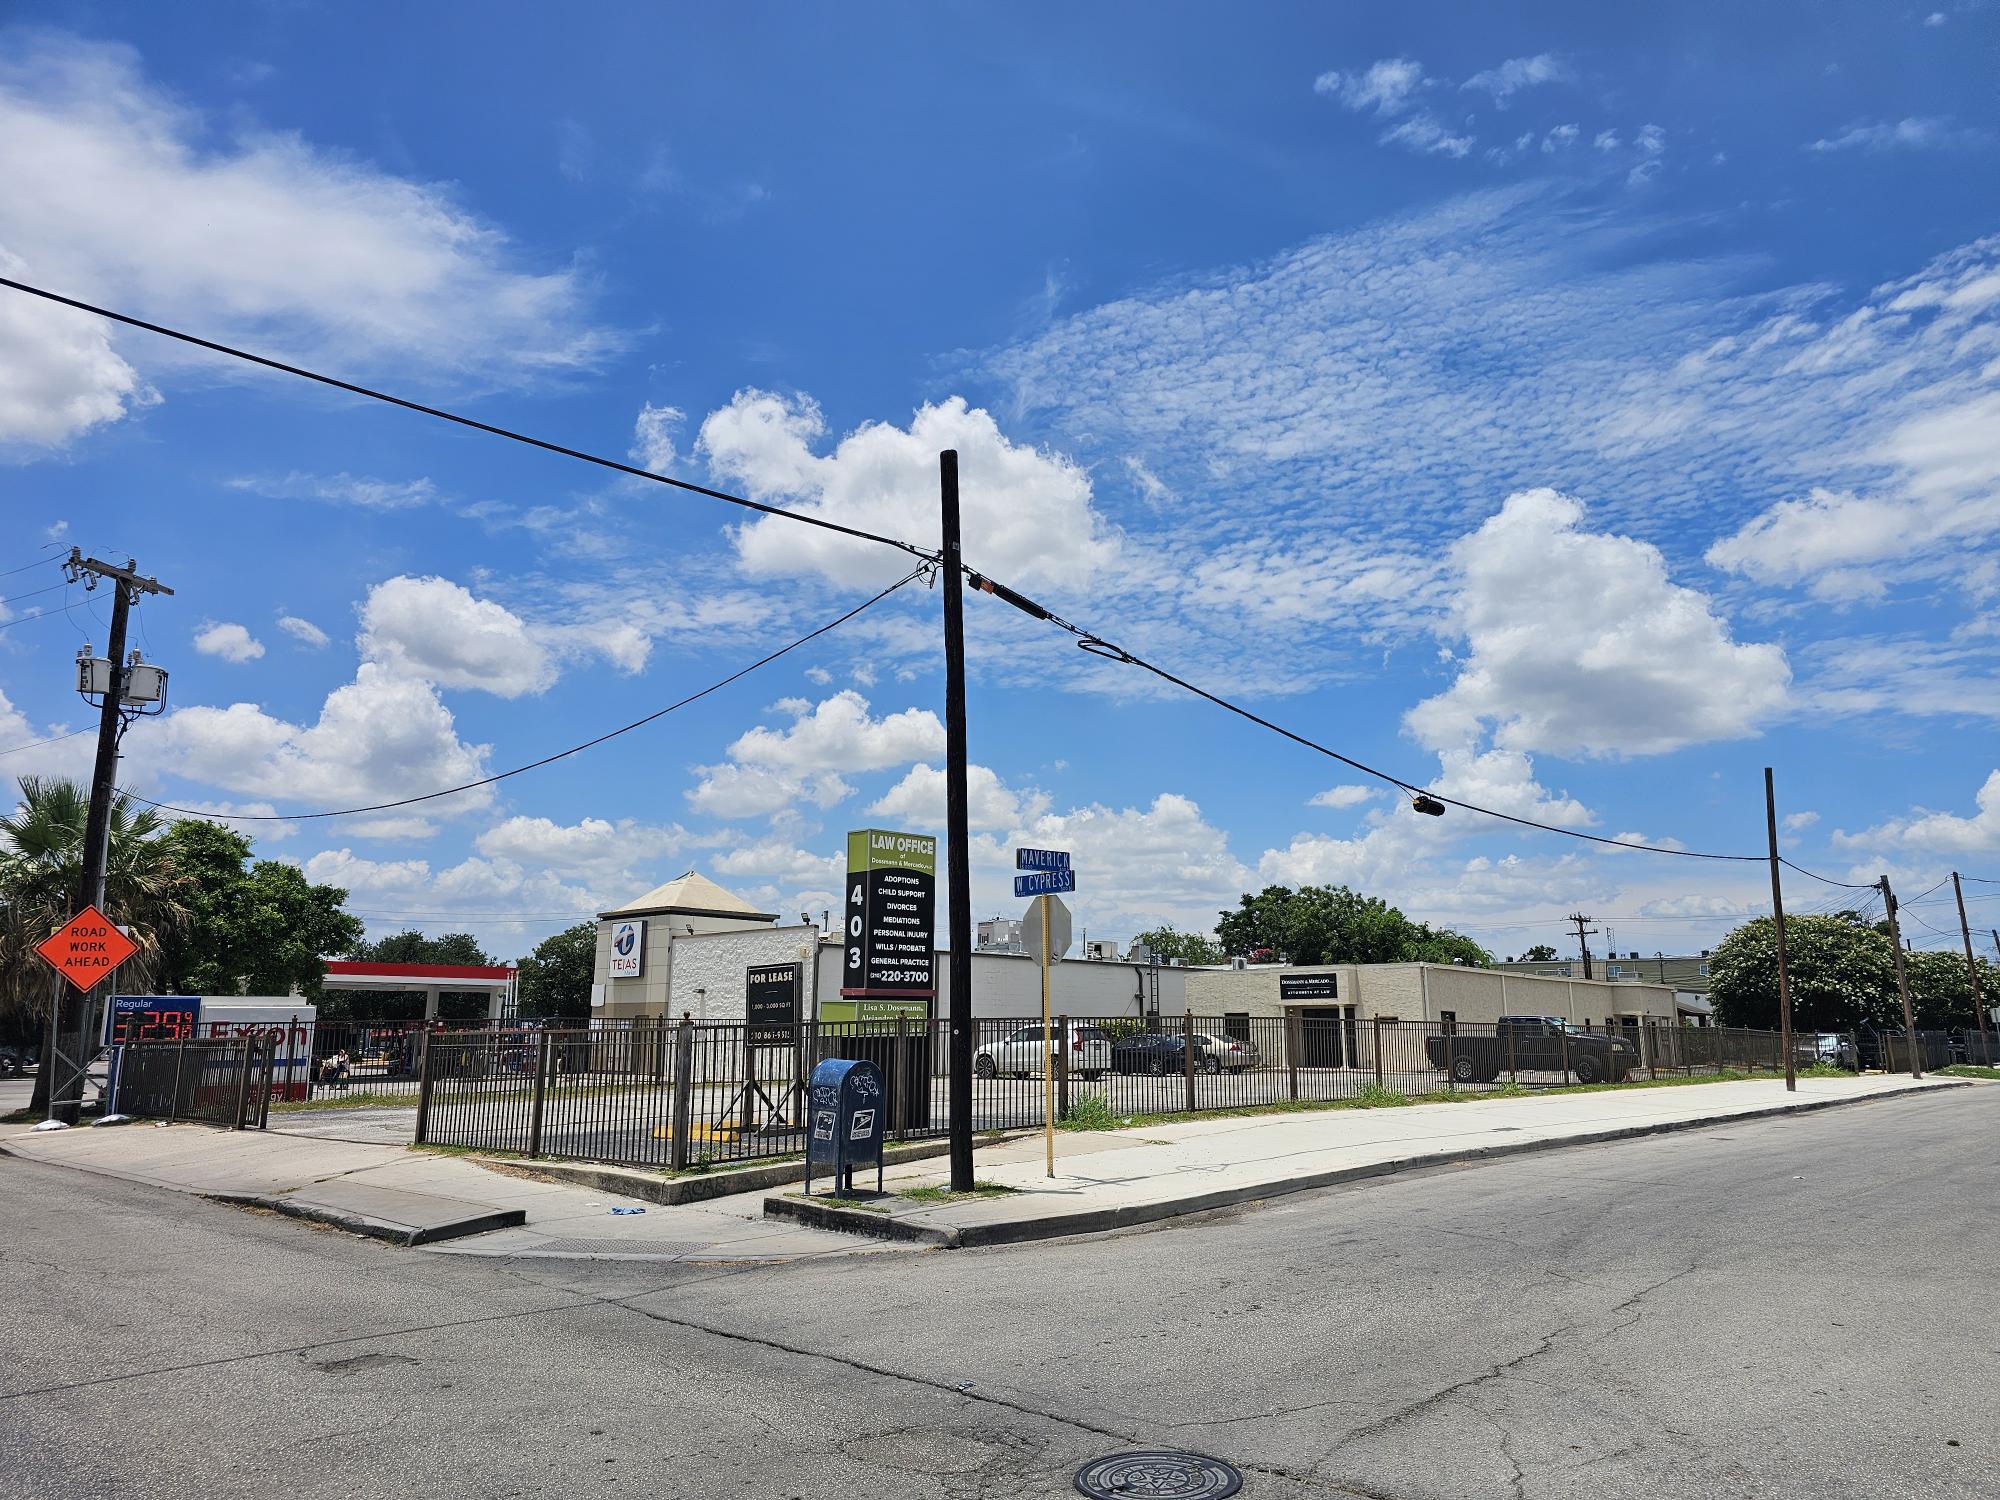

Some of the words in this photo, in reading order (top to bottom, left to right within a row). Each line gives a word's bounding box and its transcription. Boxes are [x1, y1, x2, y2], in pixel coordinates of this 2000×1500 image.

[872, 835, 895, 850] LAW
[897, 837, 933, 855] OFFICE
[1021, 849, 1069, 868] MAVERICK
[884, 875, 919, 885] ADOPTIONS
[1016, 877, 1023, 892] W
[1028, 870, 1070, 891] CYPRESS
[878, 888, 897, 896] CHILD
[897, 889, 926, 898] SUPPORT
[886, 902, 917, 911] DIVORCES
[883, 916, 920, 925] MEDIATIONS
[71, 927, 107, 937] ROAD
[873, 929, 906, 937] PERSONAL
[906, 930, 929, 938] INJURY
[70, 942, 106, 952] WORK
[875, 943, 894, 951] WILLS
[898, 944, 926, 952] PROBATE
[64, 957, 110, 967] AHEAD
[870, 957, 900, 965] GENERAL
[900, 958, 929, 966] PRACTICE
[750, 973, 767, 984] FOR
[768, 971, 793, 983] LEASE
[116, 1000, 153, 1010] Regular
[863, 1003, 878, 1011] Lisa
[879, 1003, 886, 1011] S.
